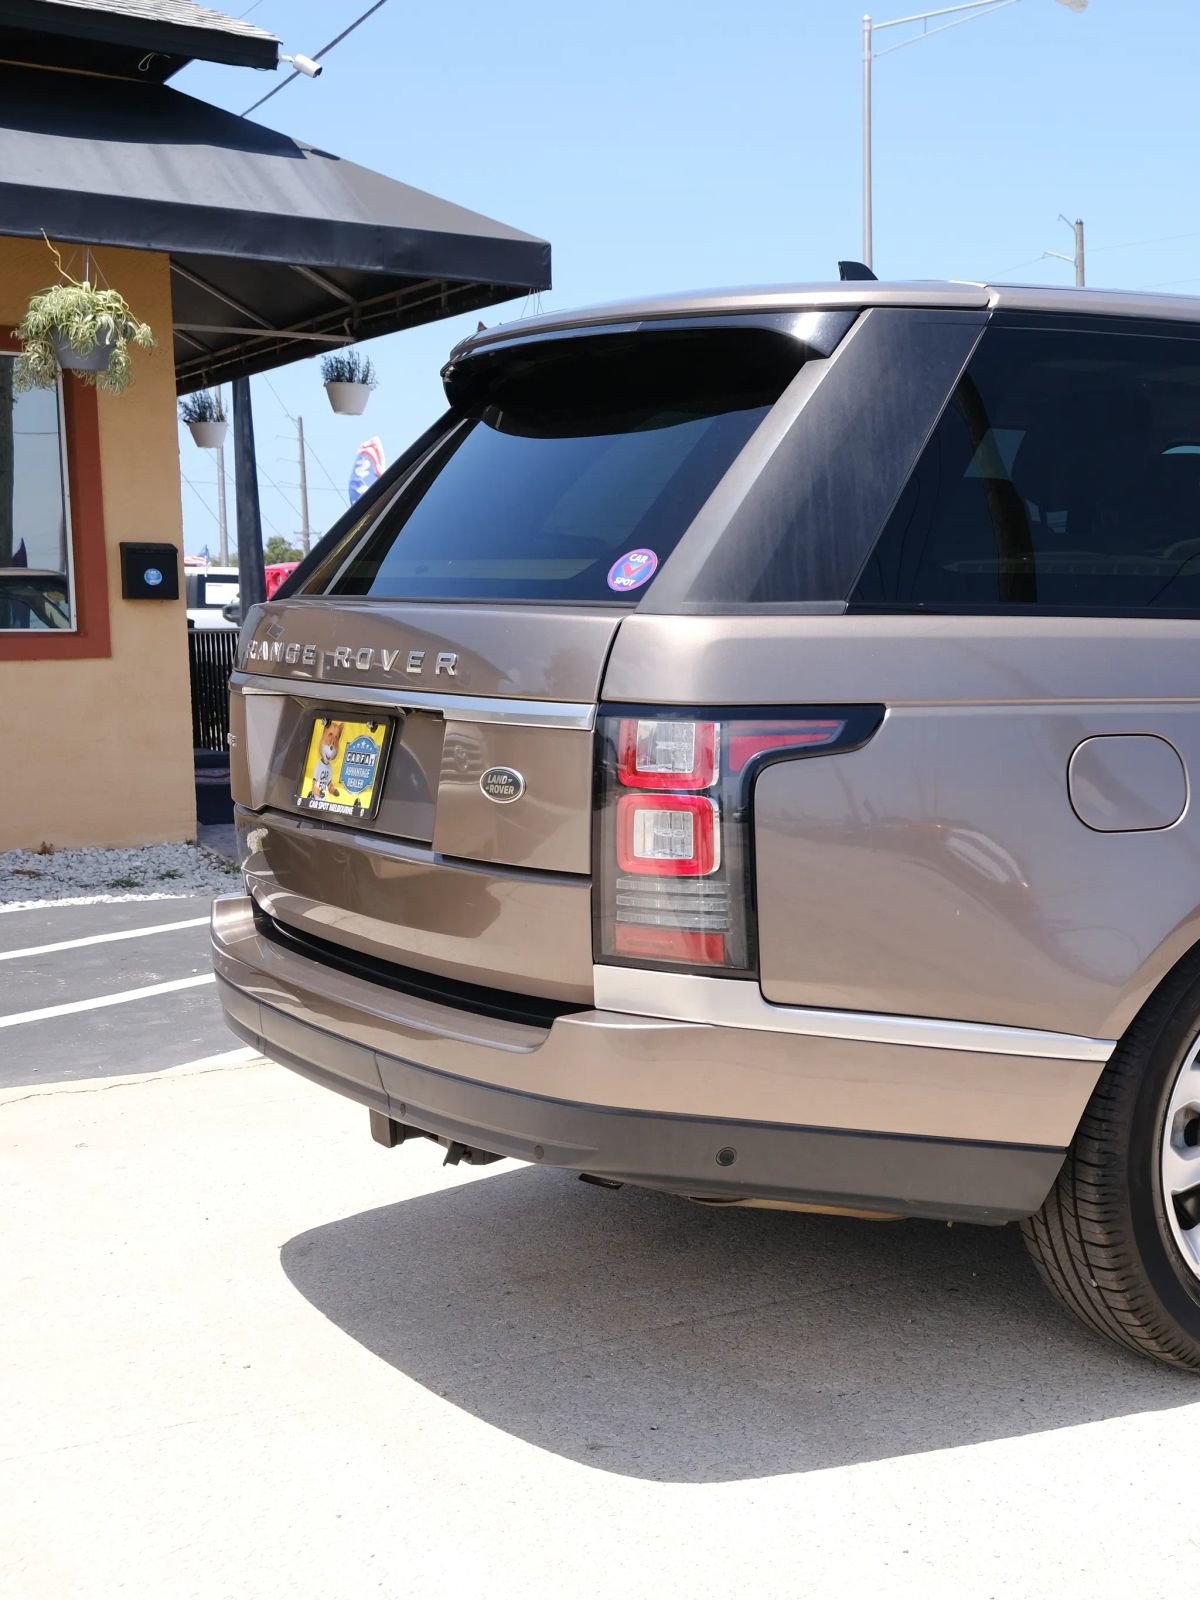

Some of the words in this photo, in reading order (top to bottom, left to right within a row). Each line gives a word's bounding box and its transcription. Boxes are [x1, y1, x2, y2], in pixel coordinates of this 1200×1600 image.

[629, 554, 649, 564] CAR
[614, 577, 636, 586] SPOT
[246, 640, 317, 665] RANGE
[333, 646, 459, 676] ROVER
[488, 775, 508, 785] LAND
[489, 785, 515, 795] ROVER
[309, 800, 318, 809] CAR
[318, 801, 330, 810] SPOT
